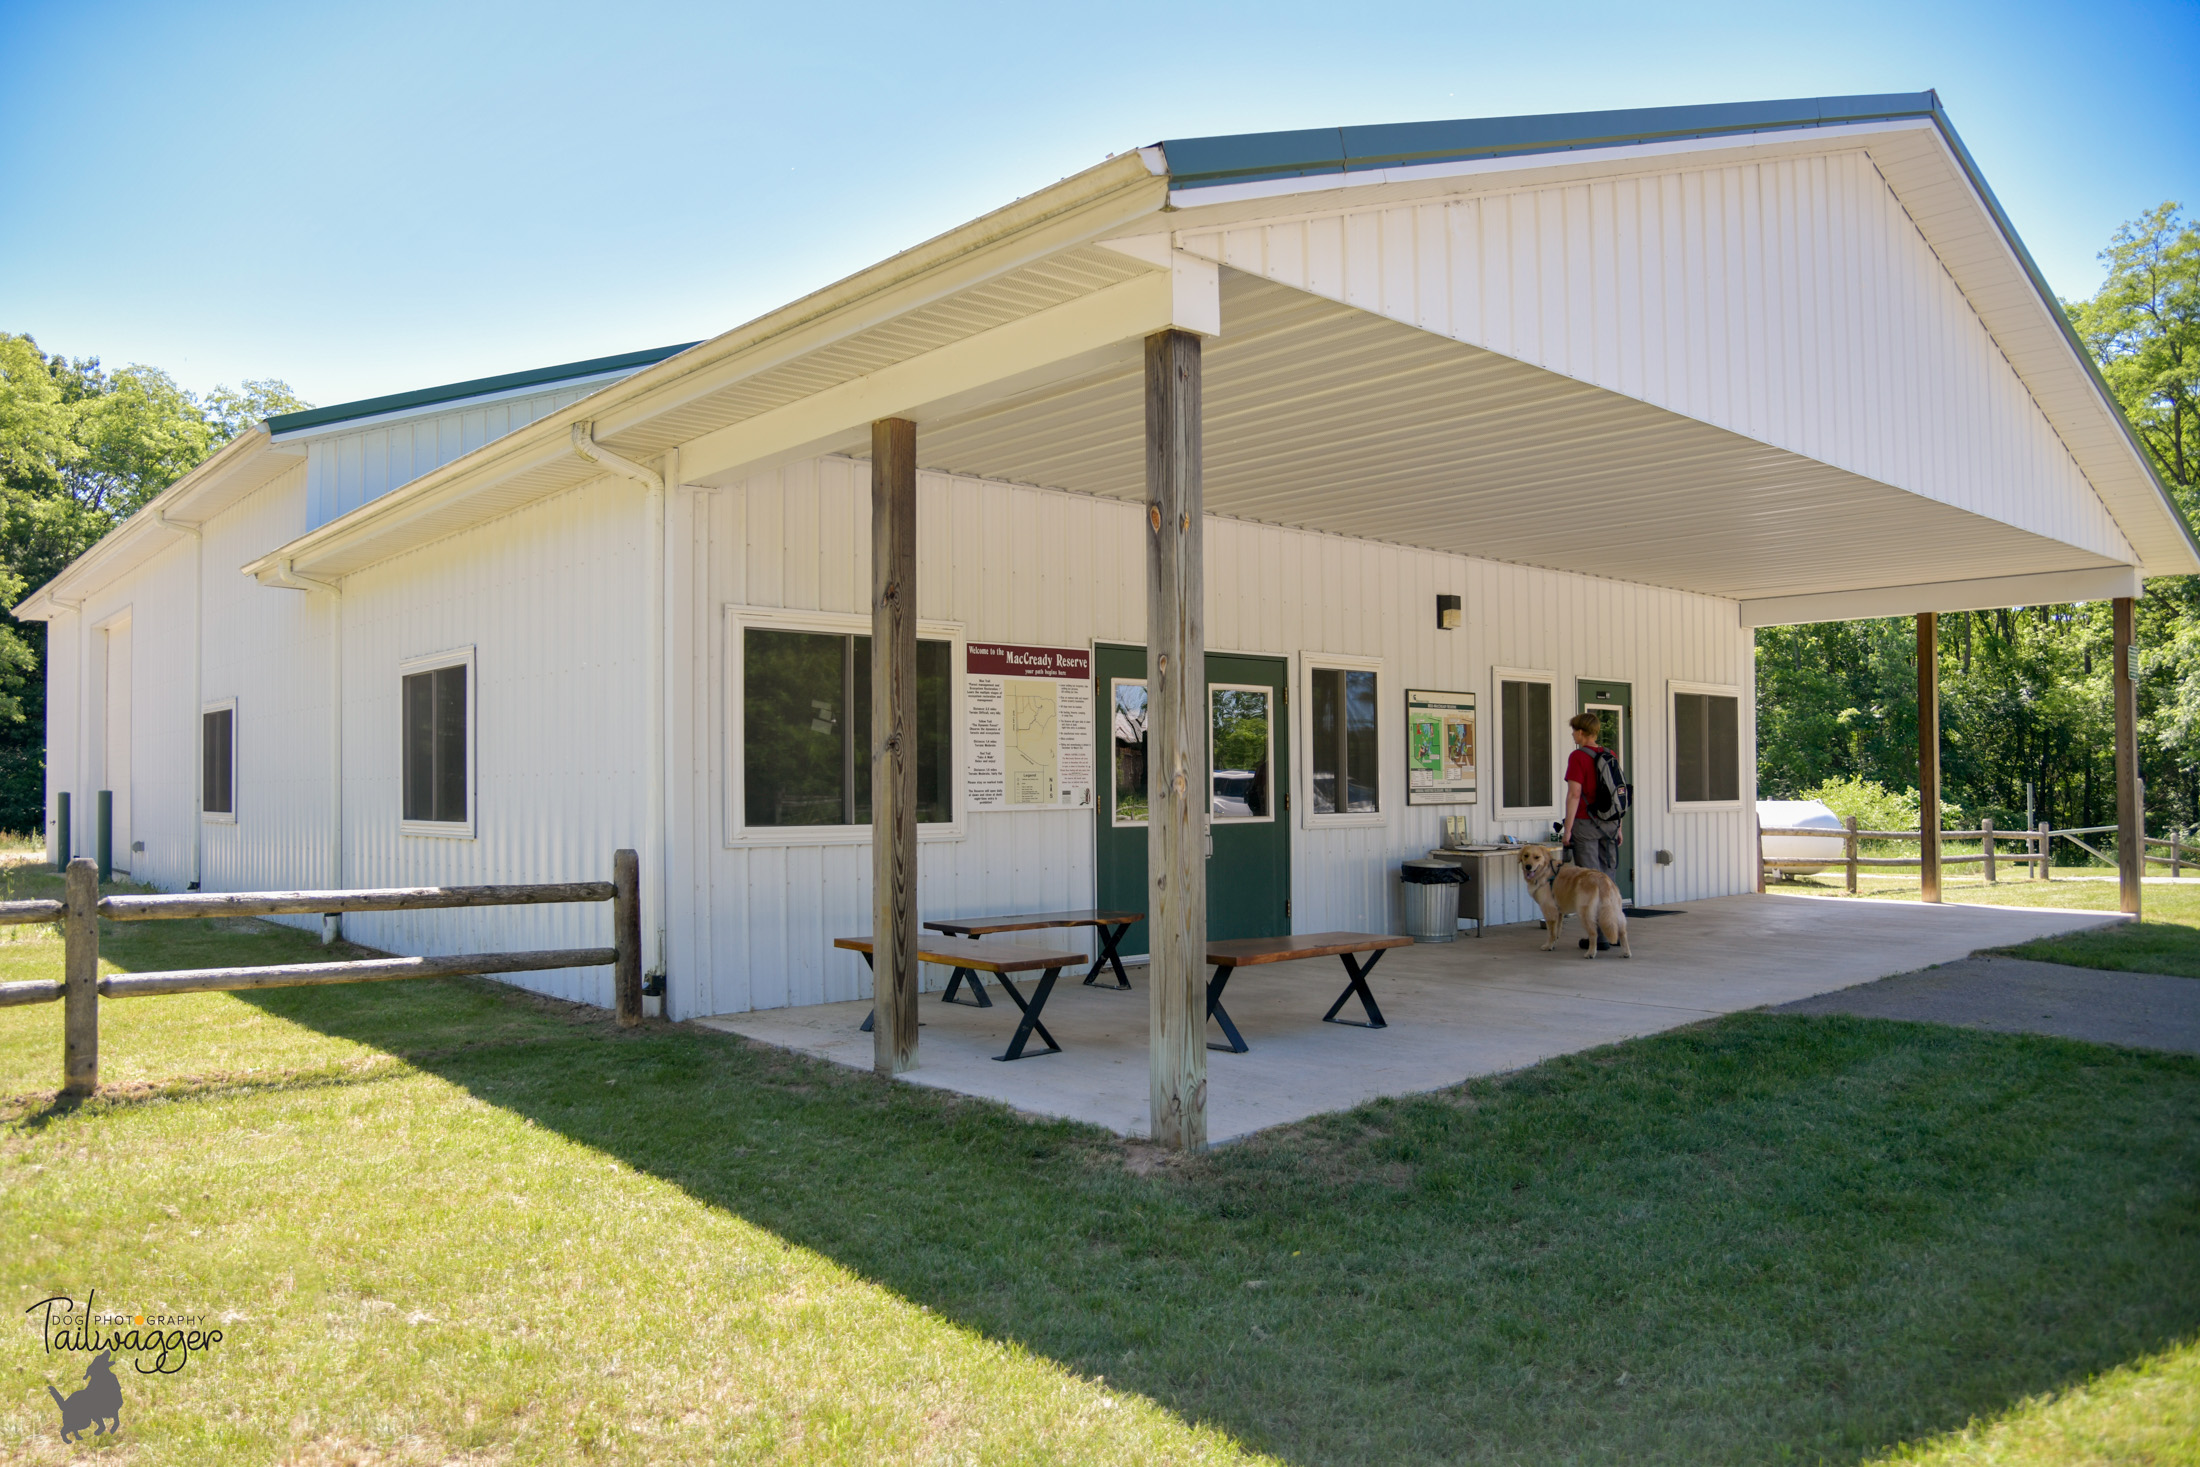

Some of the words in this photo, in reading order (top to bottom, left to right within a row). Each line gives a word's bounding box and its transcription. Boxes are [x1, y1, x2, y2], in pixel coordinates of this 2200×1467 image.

[969, 645, 989, 655] Welcome
[1006, 651, 1052, 669] MacCready
[1056, 654, 1087, 668] Reserve
